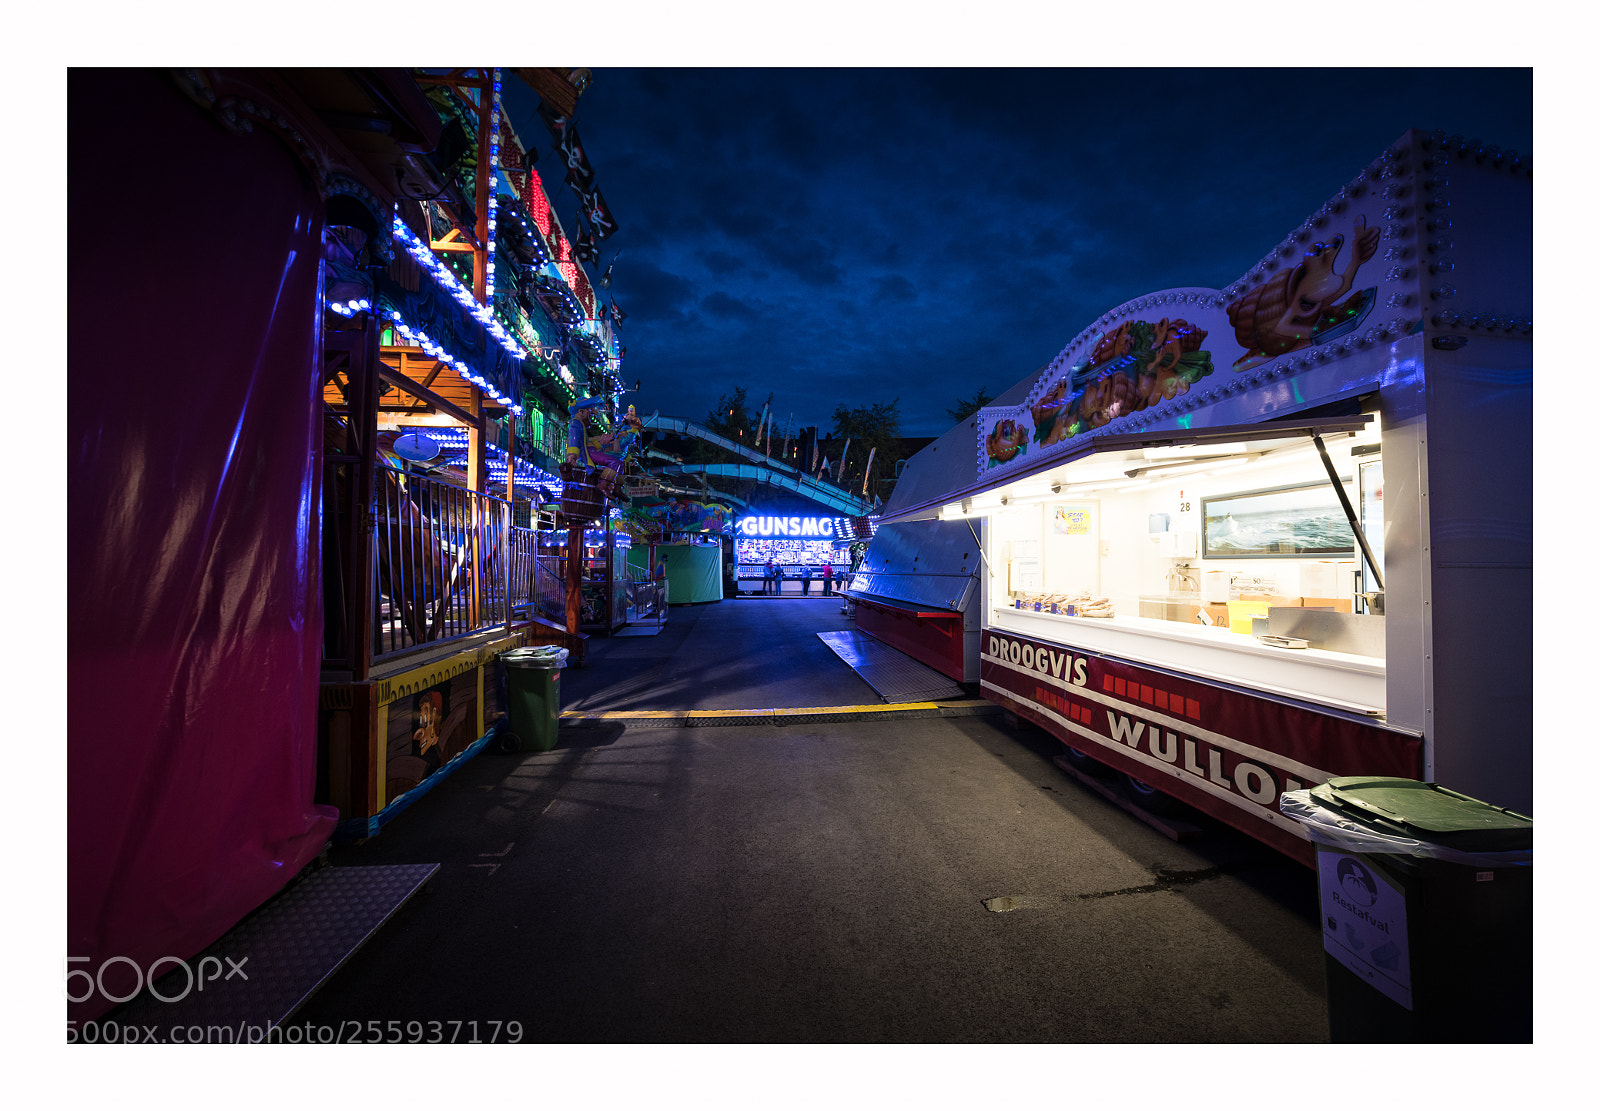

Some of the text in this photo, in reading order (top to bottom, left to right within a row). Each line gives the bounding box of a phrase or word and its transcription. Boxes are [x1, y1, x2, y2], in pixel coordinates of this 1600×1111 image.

[1180, 502, 1191, 512] 28
[989, 635, 1088, 687] DROOGVIS
[1332, 891, 1390, 935] Restafval
